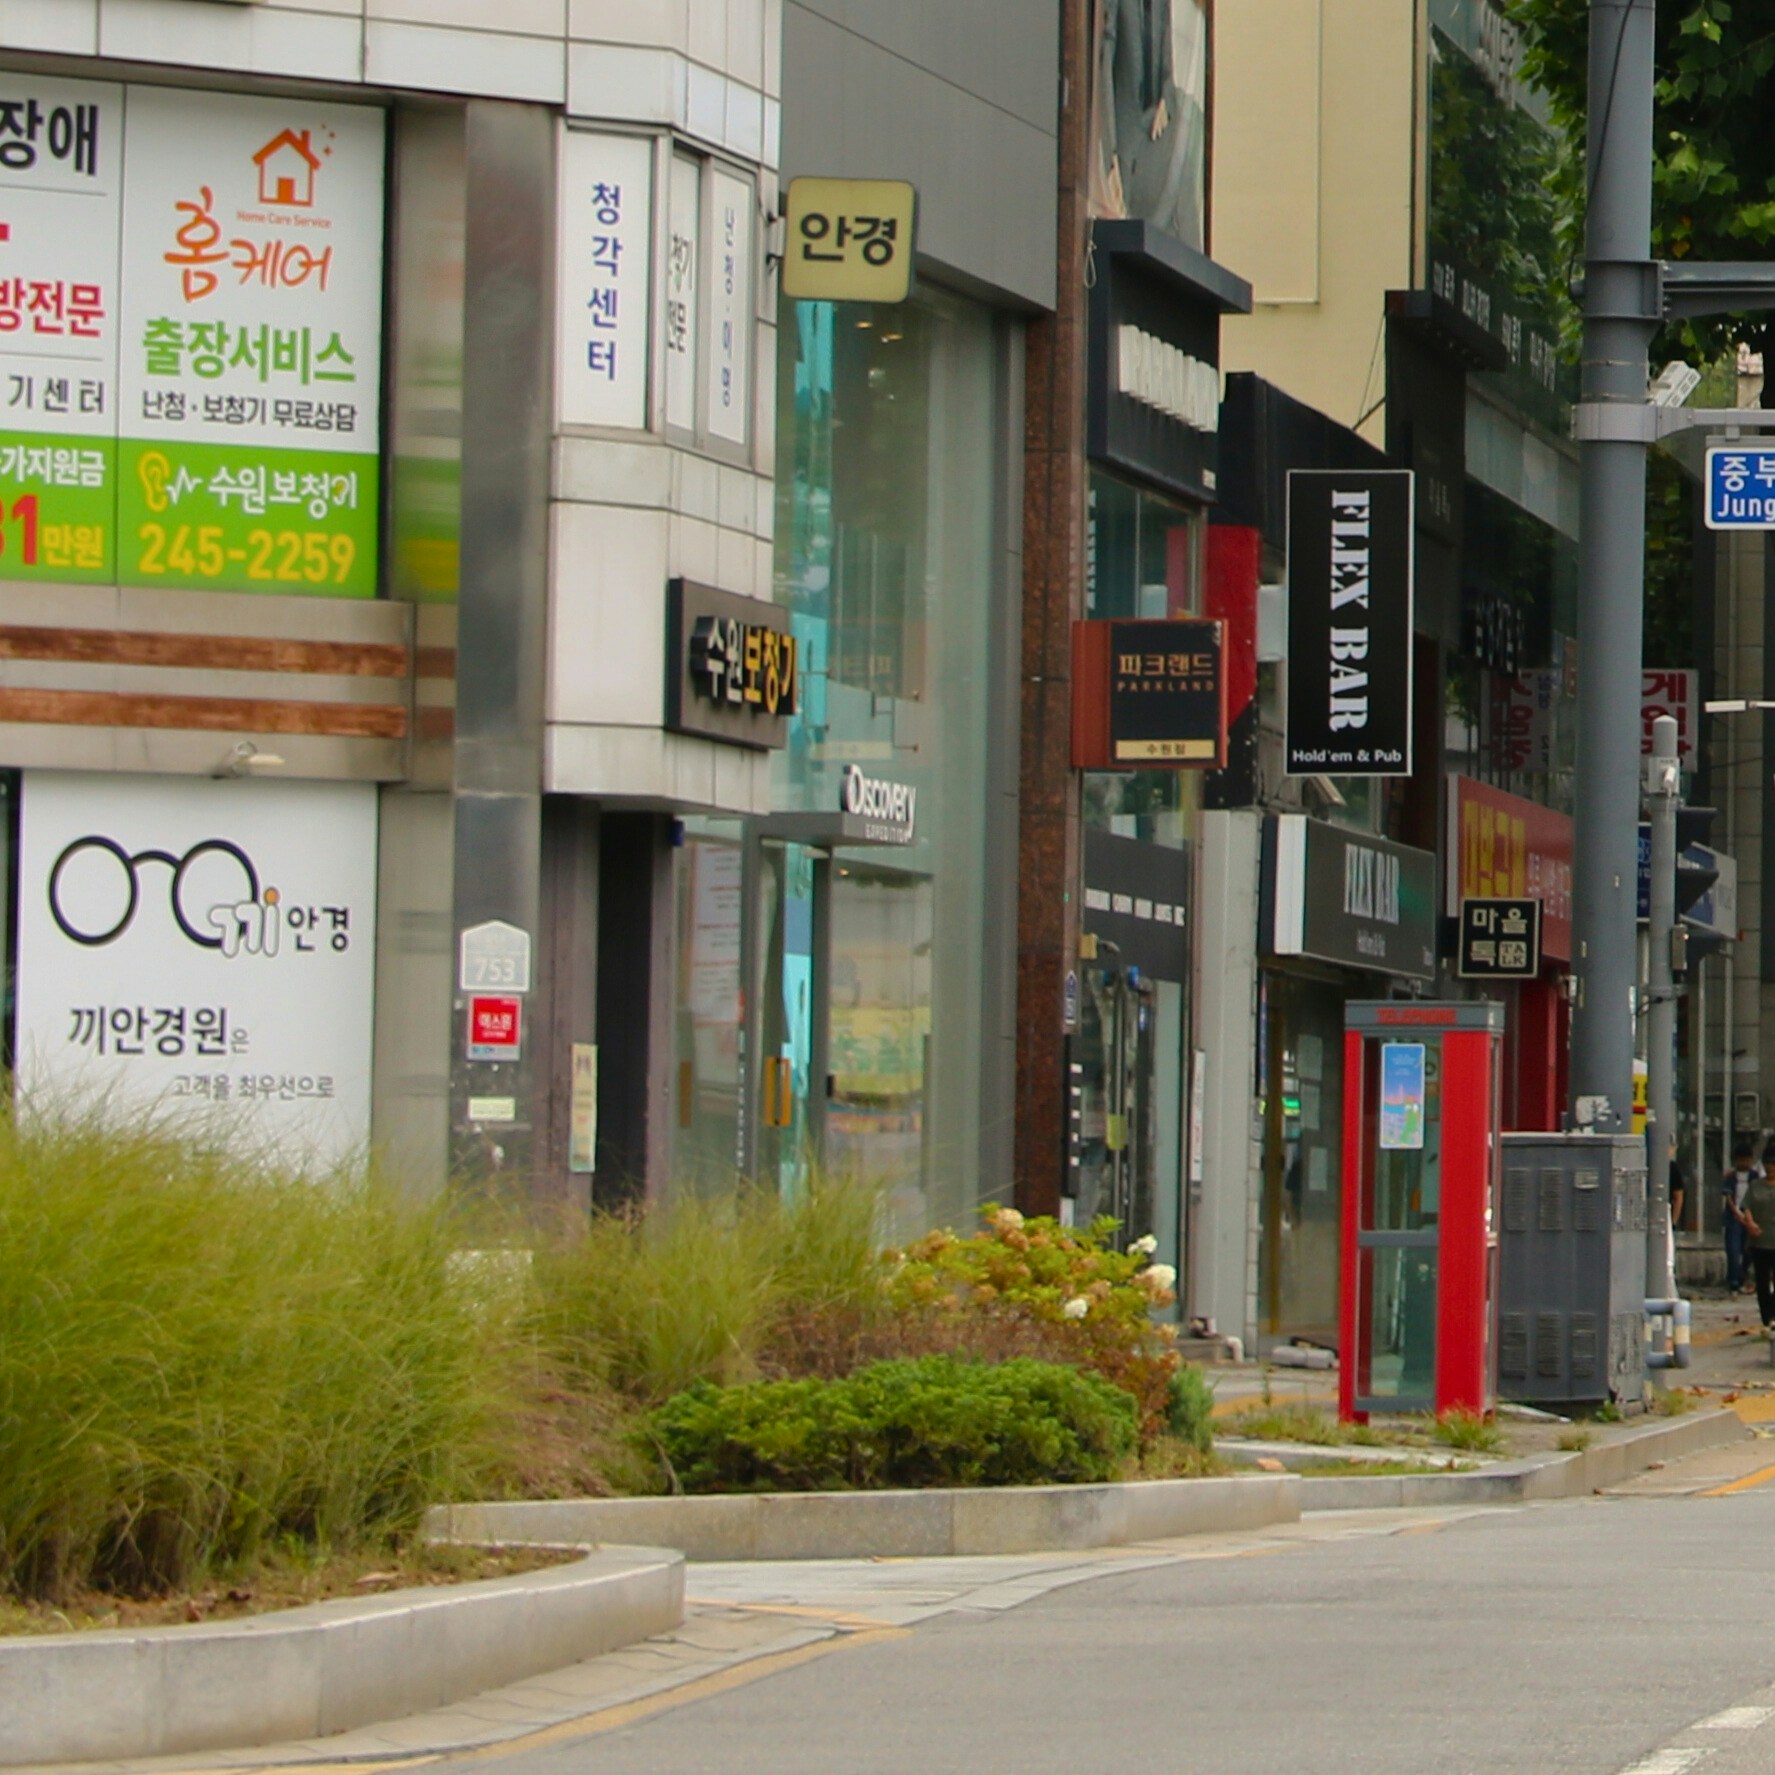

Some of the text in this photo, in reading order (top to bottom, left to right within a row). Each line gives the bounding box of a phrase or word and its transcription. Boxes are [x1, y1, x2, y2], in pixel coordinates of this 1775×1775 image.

[164, 185, 332, 302] 홈케어
[800, 211, 896, 266] 안경
[587, 182, 622, 381] 청각센터
[142, 317, 356, 385] 출장서비스
[273, 397, 357, 432] 무료상담
[42, 525, 103, 568] 만원
[139, 524, 355, 584] 245-2259
[1329, 490, 1370, 733] FLEX BAR
[706, 616, 797, 715] 수원보청기
[1117, 681, 1214, 692] PARKLAND
[1119, 654, 1214, 676] 파크랜드
[1293, 750, 1402, 764] Hold'em & Pub
[287, 906, 350, 953] 안경
[1472, 907, 1528, 934] 마을
[475, 958, 516, 983] 753
[1376, 1008, 1458, 1024] TELEPHONE
